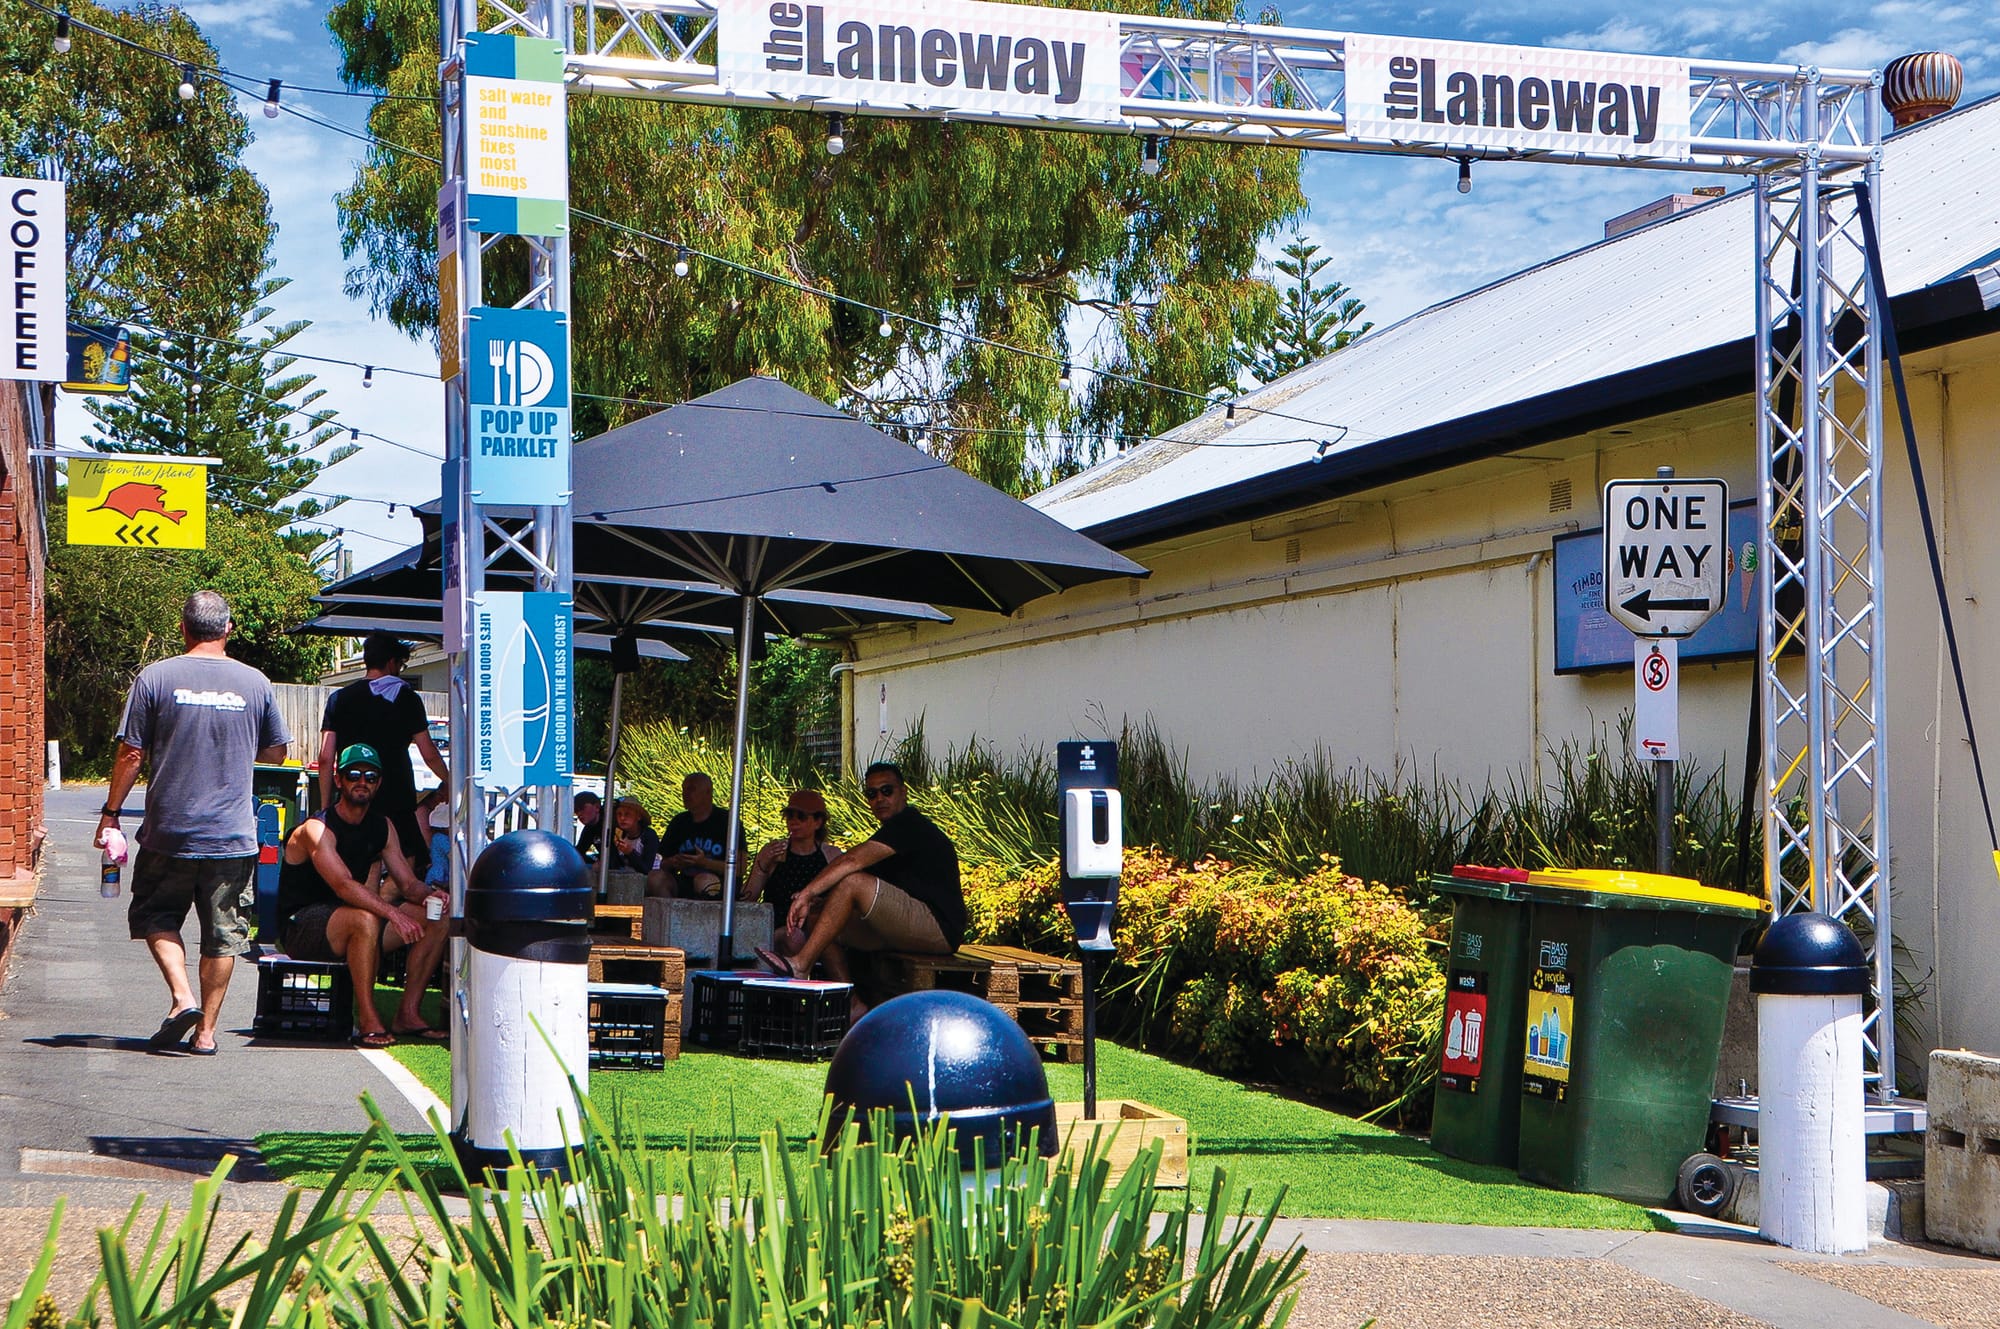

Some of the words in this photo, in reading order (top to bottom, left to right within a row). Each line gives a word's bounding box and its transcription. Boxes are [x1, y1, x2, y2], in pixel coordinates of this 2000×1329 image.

[763, 2, 803, 72] the
[806, 5, 1086, 105] Laneway
[479, 87, 507, 103] salt
[511, 91, 552, 107] water
[1384, 56, 1418, 120] the
[1421, 58, 1661, 144] Laneway
[479, 105, 507, 121] and
[479, 122, 548, 141] sunshine
[480, 138, 516, 155] fixes
[480, 157, 517, 171] most
[480, 172, 528, 190] things
[10, 188, 40, 370] COFFEE
[481, 409, 523, 434] POP
[529, 411, 558, 435] UP
[481, 436, 558, 458] PARKLET
[78, 459, 113, 479] Thai
[116, 467, 131, 475] on
[132, 464, 153, 477] the
[153, 464, 196, 483] Island
[1625, 496, 1707, 531] ONE
[1619, 545, 1712, 578] WAY
[555, 614, 567, 647] COAST
[480, 643, 491, 671] GOOD
[555, 649, 567, 676] BASS
[480, 673, 491, 687] ON
[555, 677, 567, 696] THE
[480, 689, 491, 708] THE
[555, 698, 567, 712] ON
[480, 710, 491, 737] BASS
[555, 714, 567, 742] GOOD
[480, 739, 491, 772] COAST
[1467, 933, 1482, 948] BASS
[1551, 941, 1568, 957] BASS
[1551, 955, 1567, 967] COAST
[1544, 970, 1566, 984] recycle
